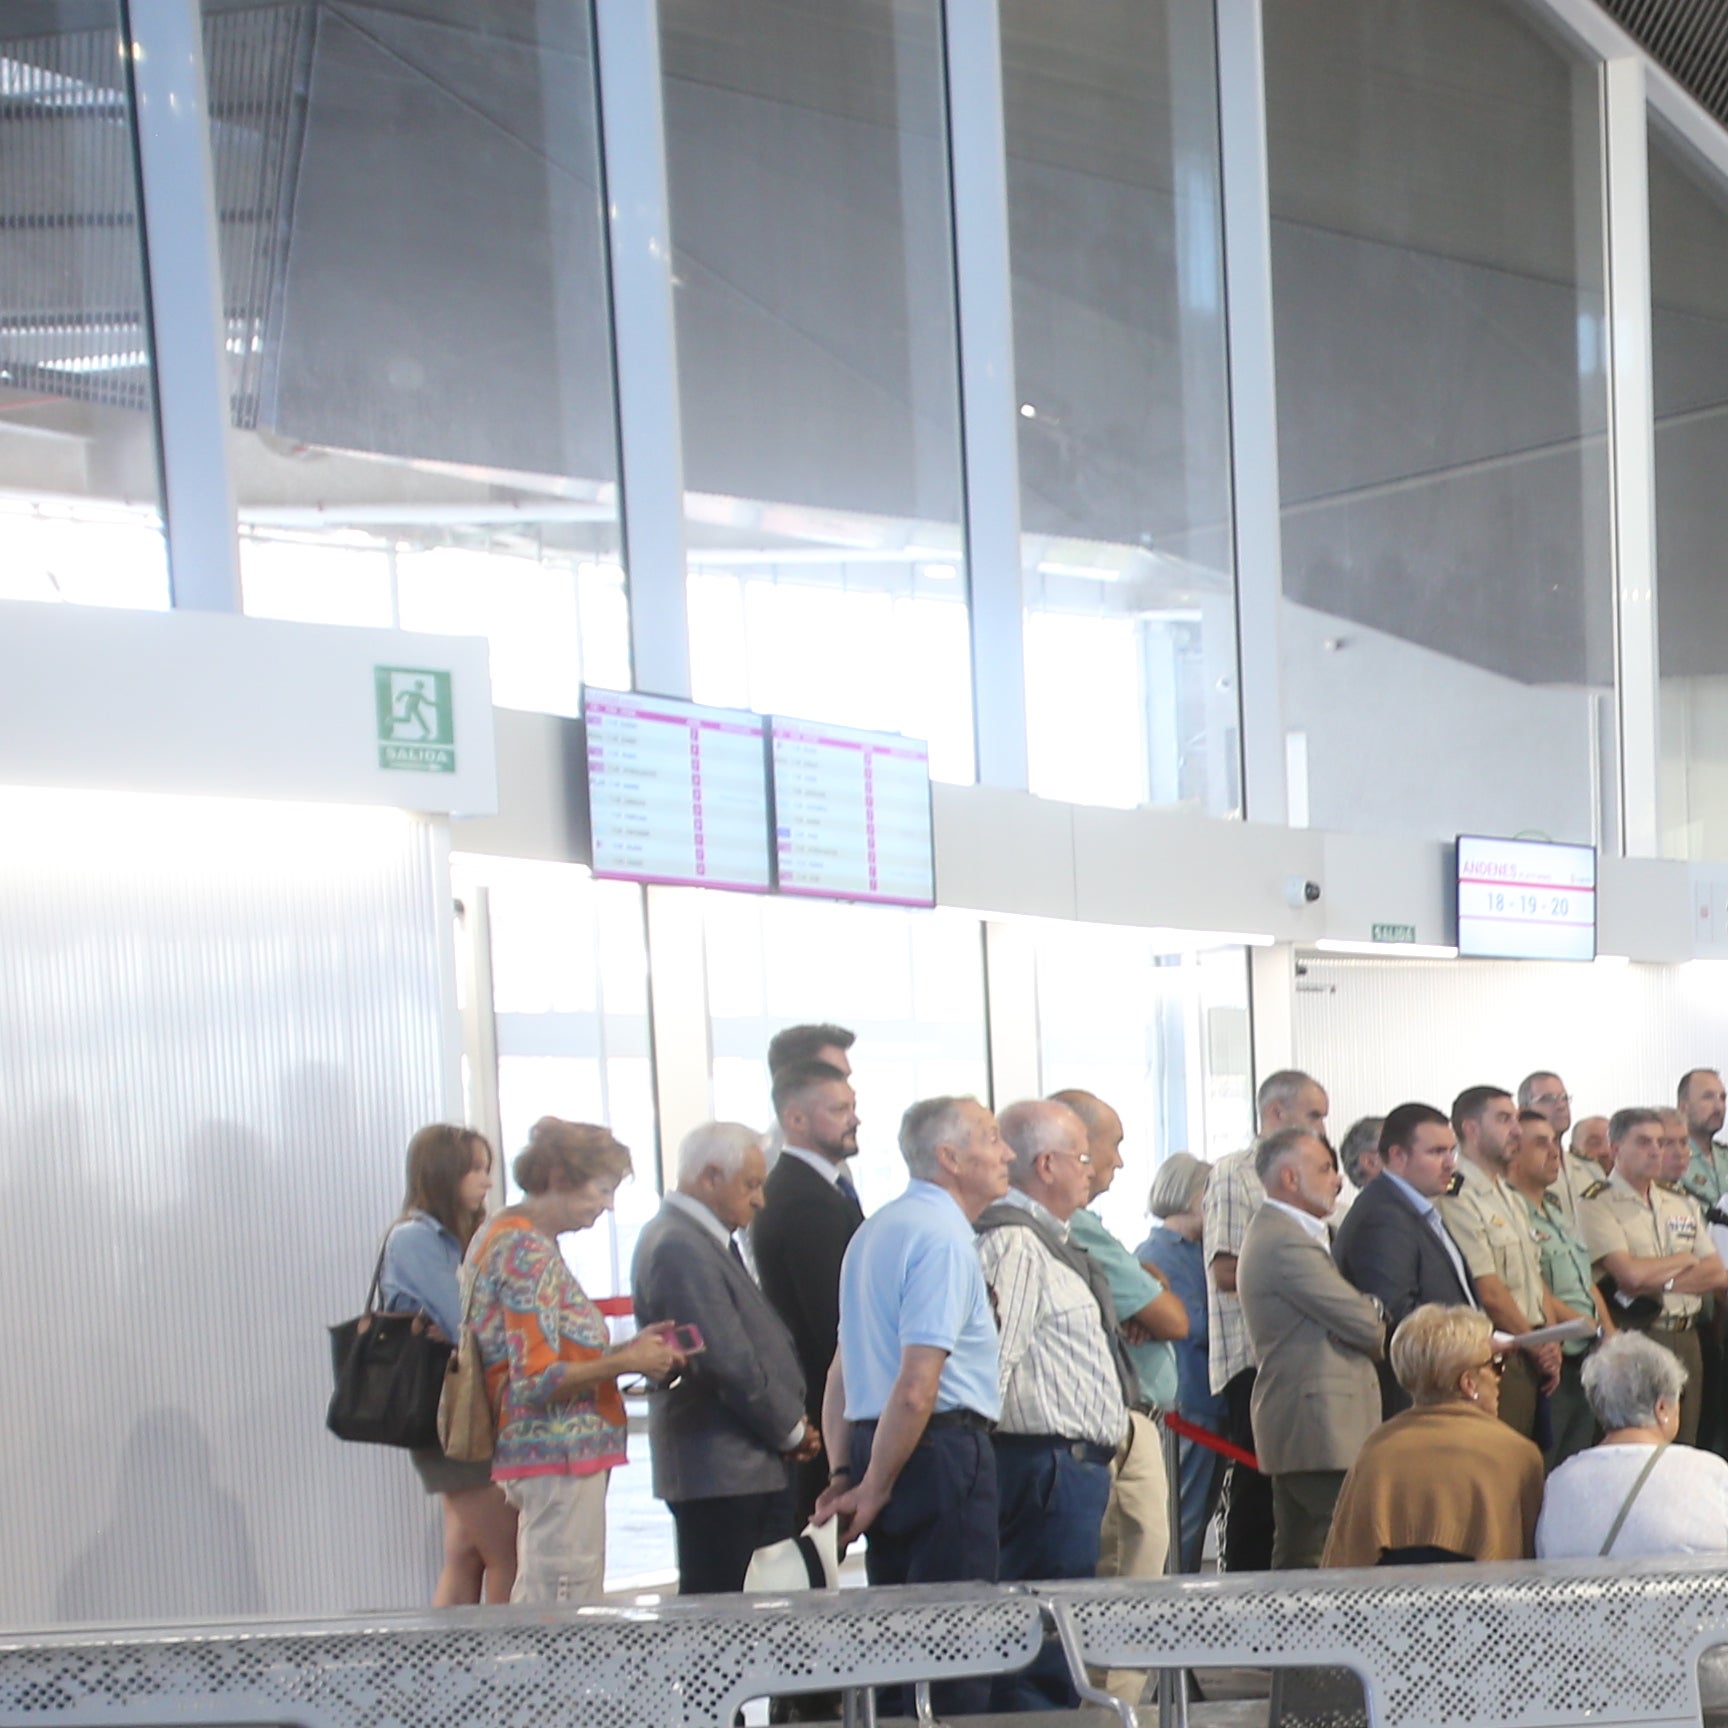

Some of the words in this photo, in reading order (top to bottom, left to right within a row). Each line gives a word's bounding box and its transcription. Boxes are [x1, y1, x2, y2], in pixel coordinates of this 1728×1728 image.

[384, 746, 448, 762] SALIDA
[1463, 860, 1517, 879] ANDENES
[1488, 892, 1505, 912] 18
[1521, 895, 1538, 914] 19
[1551, 897, 1569, 916] 20
